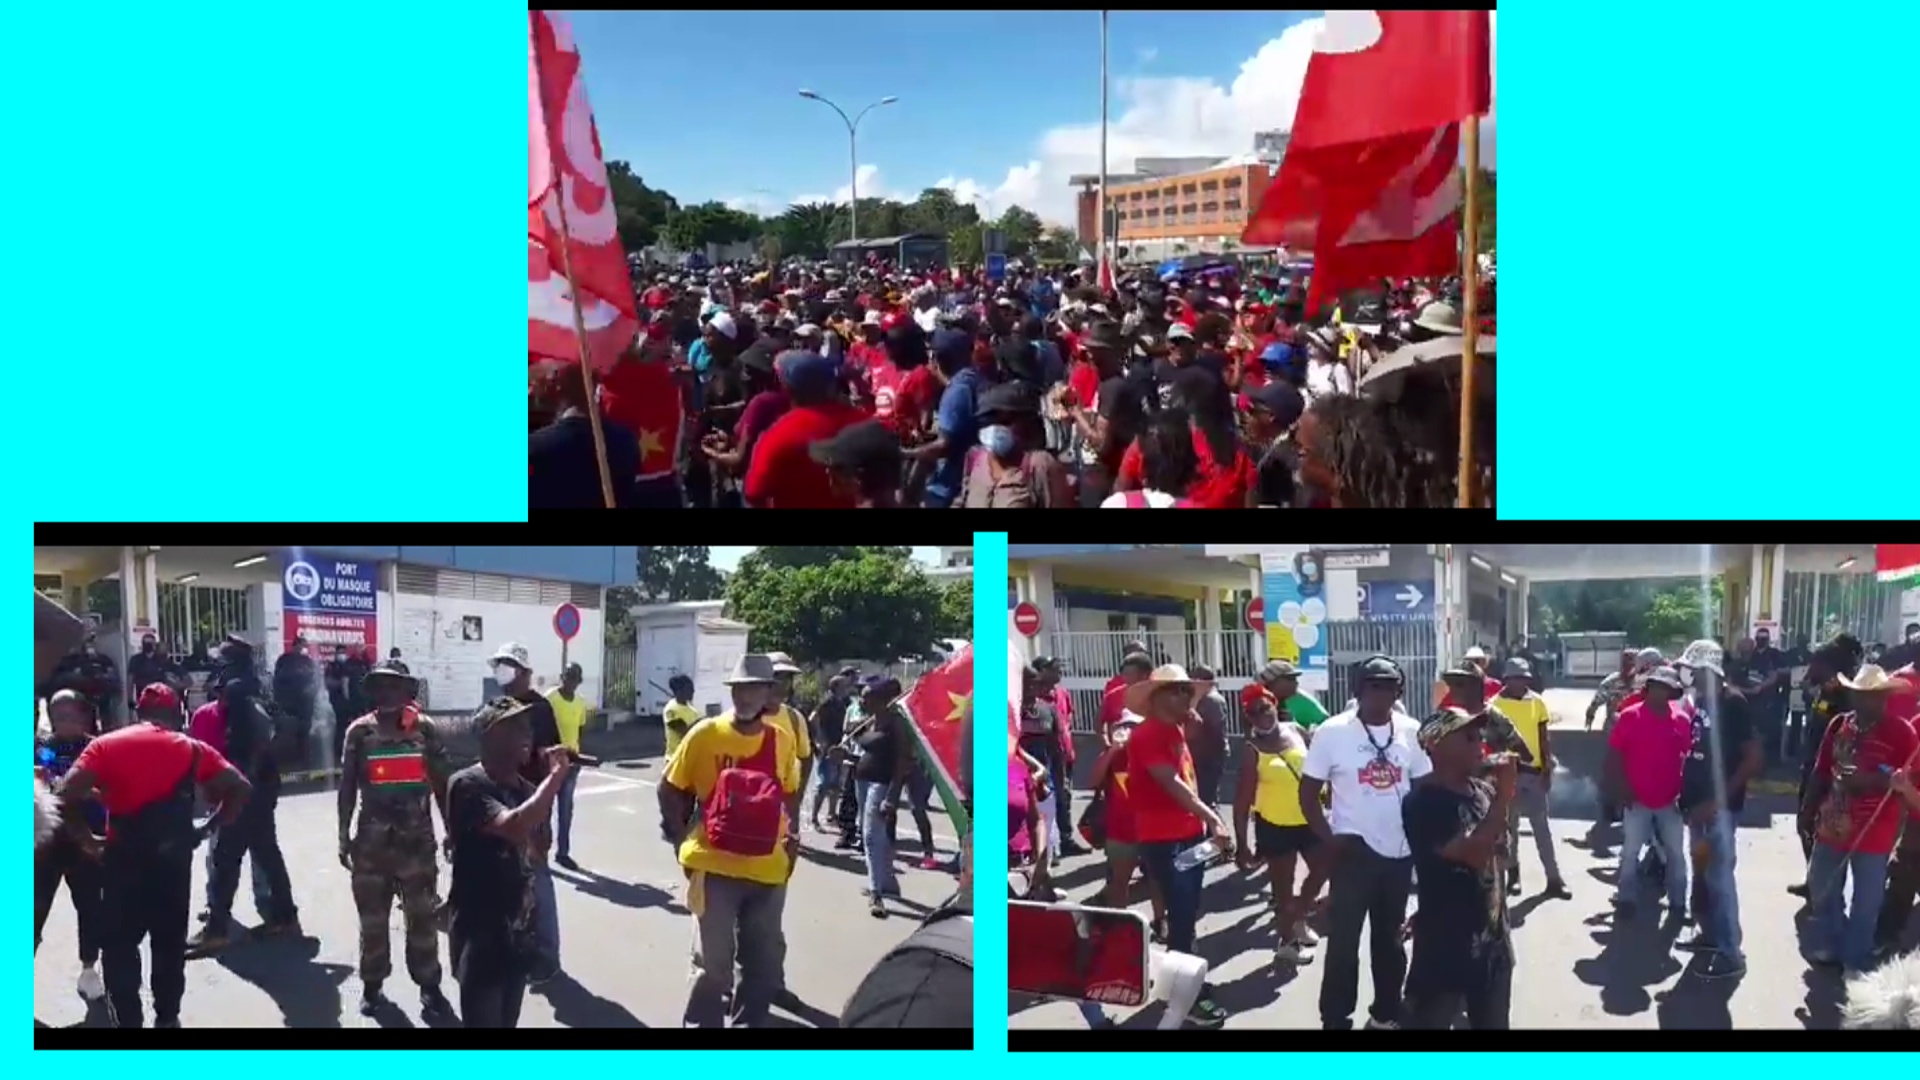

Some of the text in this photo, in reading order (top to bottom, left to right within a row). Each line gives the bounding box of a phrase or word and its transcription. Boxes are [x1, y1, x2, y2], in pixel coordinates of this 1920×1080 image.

[335, 562, 358, 576] PORT
[323, 577, 371, 593] DU MASQUE
[320, 594, 374, 609] OBLIGATOIRE
[335, 617, 366, 629] ADULTES
[296, 627, 366, 645] CORONAVIRUS
